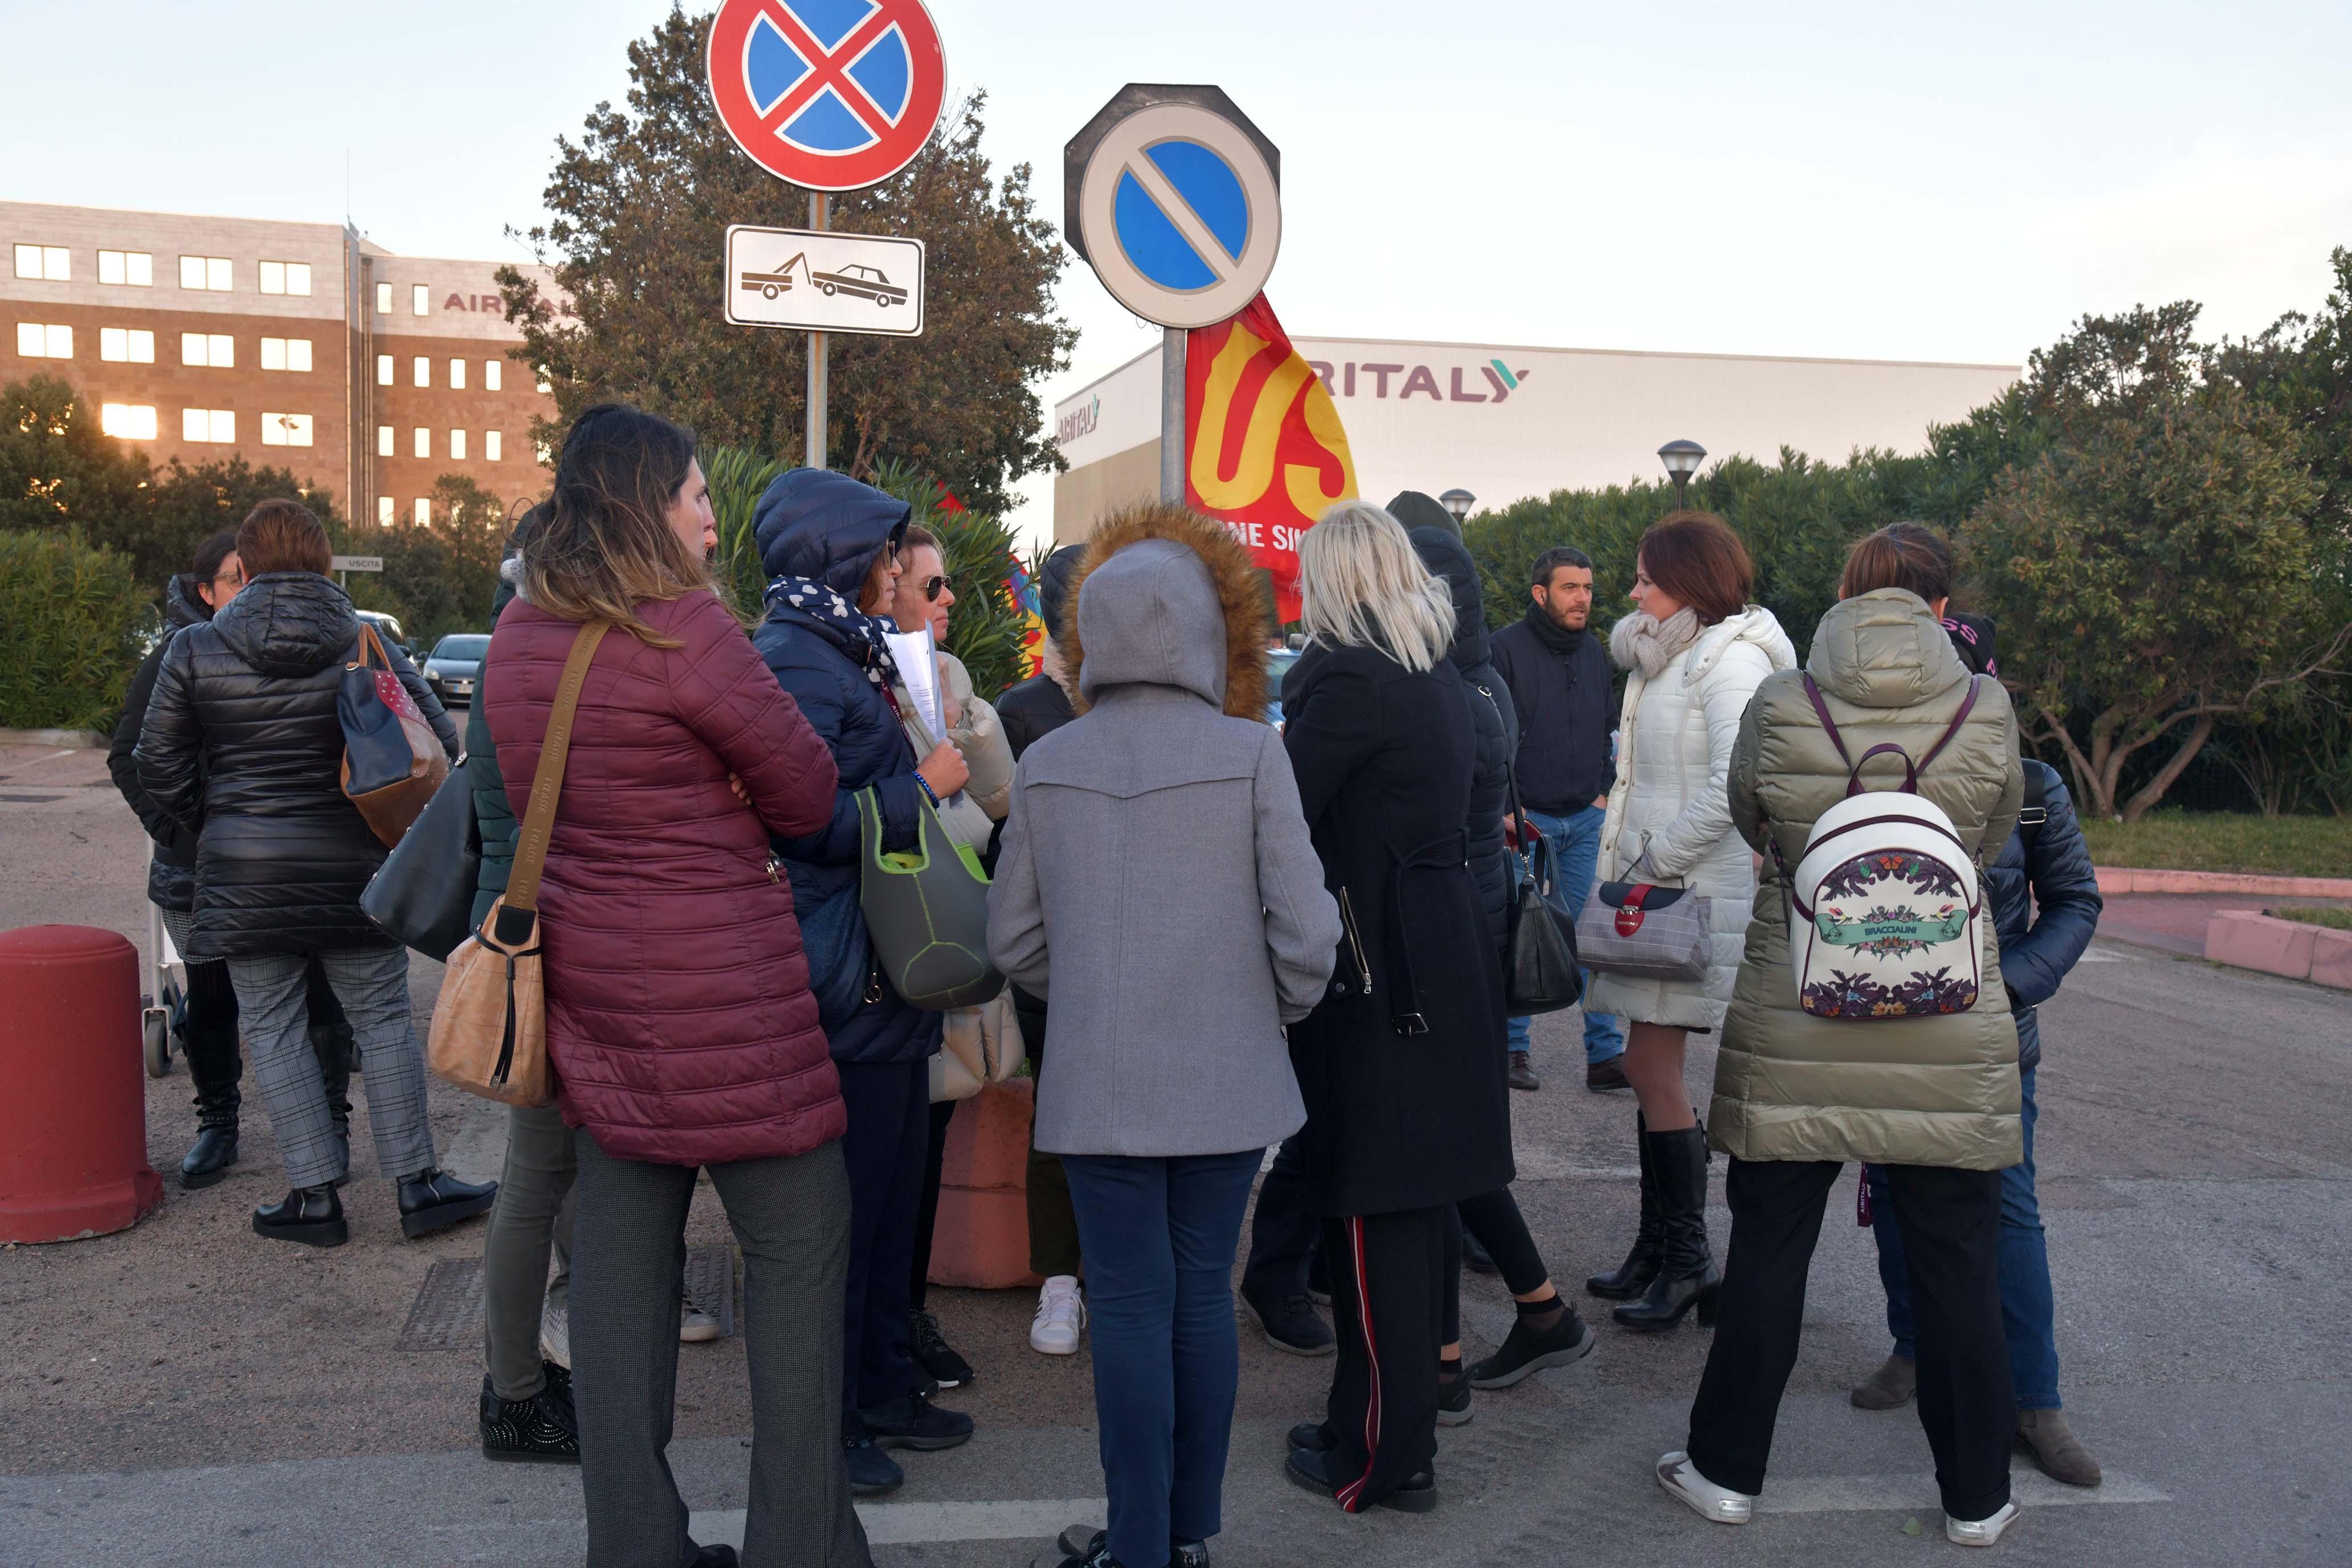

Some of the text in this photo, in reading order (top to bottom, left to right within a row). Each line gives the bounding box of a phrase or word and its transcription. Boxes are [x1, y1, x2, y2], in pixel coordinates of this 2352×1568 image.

[1305, 360, 1530, 403] RITALY
[891, 705, 907, 735] AIRITAL
[1864, 925, 1917, 936] BRACCIALINI
